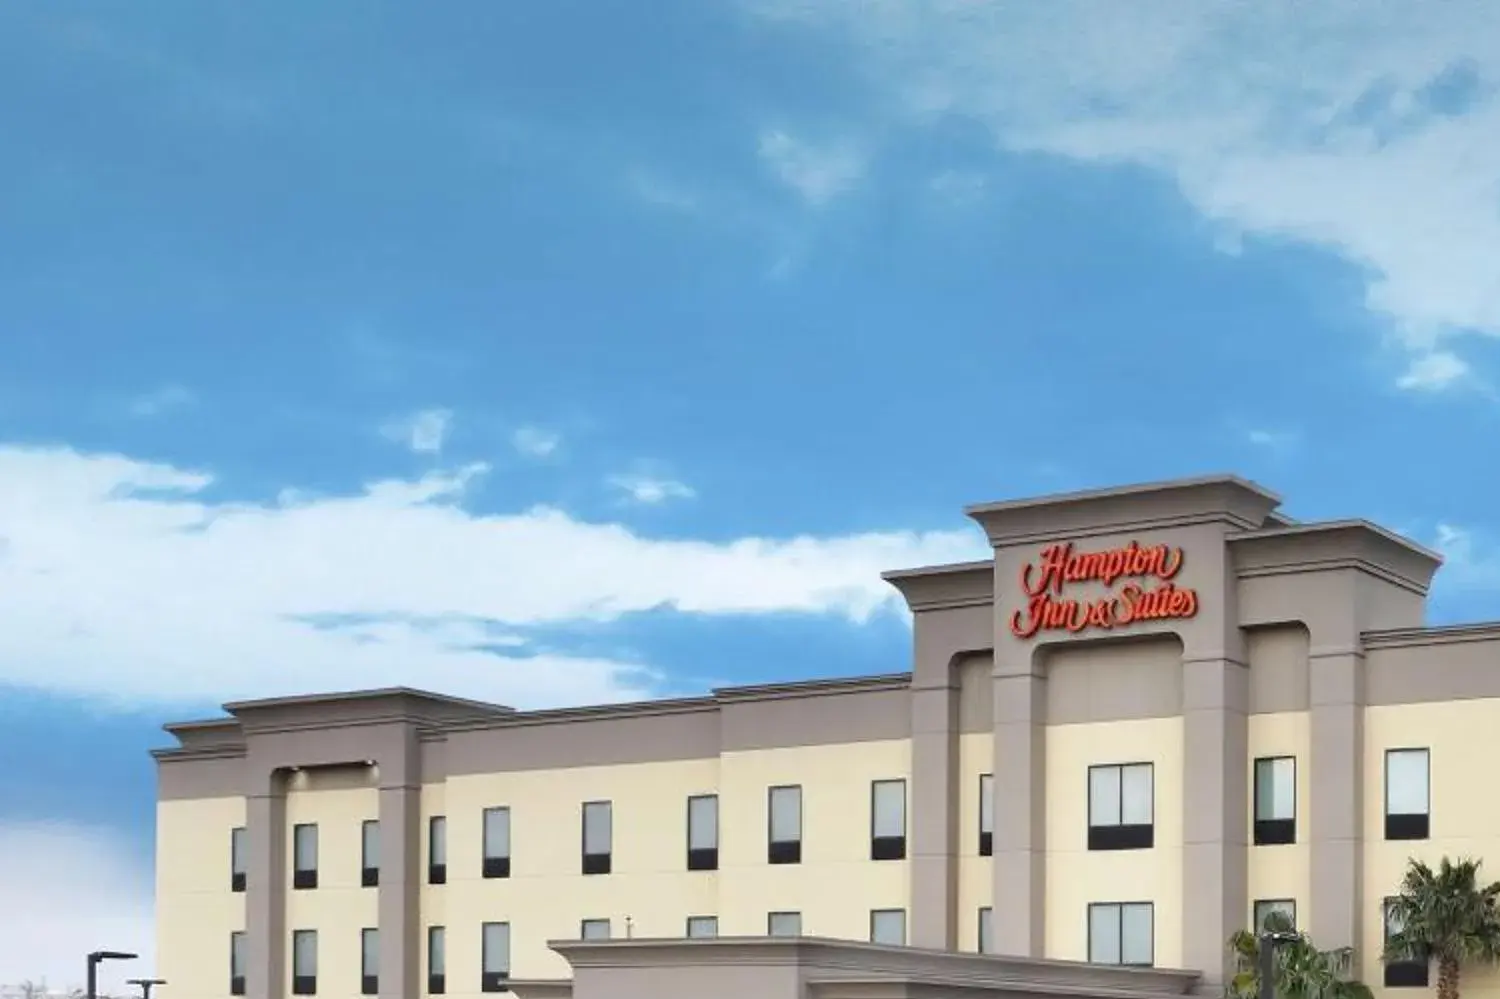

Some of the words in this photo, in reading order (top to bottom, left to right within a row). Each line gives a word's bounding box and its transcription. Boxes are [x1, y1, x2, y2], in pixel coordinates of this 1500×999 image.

[1021, 541, 1183, 595] Hampton
[1010, 594, 1091, 639] Inn
[1089, 600, 1114, 628] &
[1114, 583, 1197, 624] Suites
